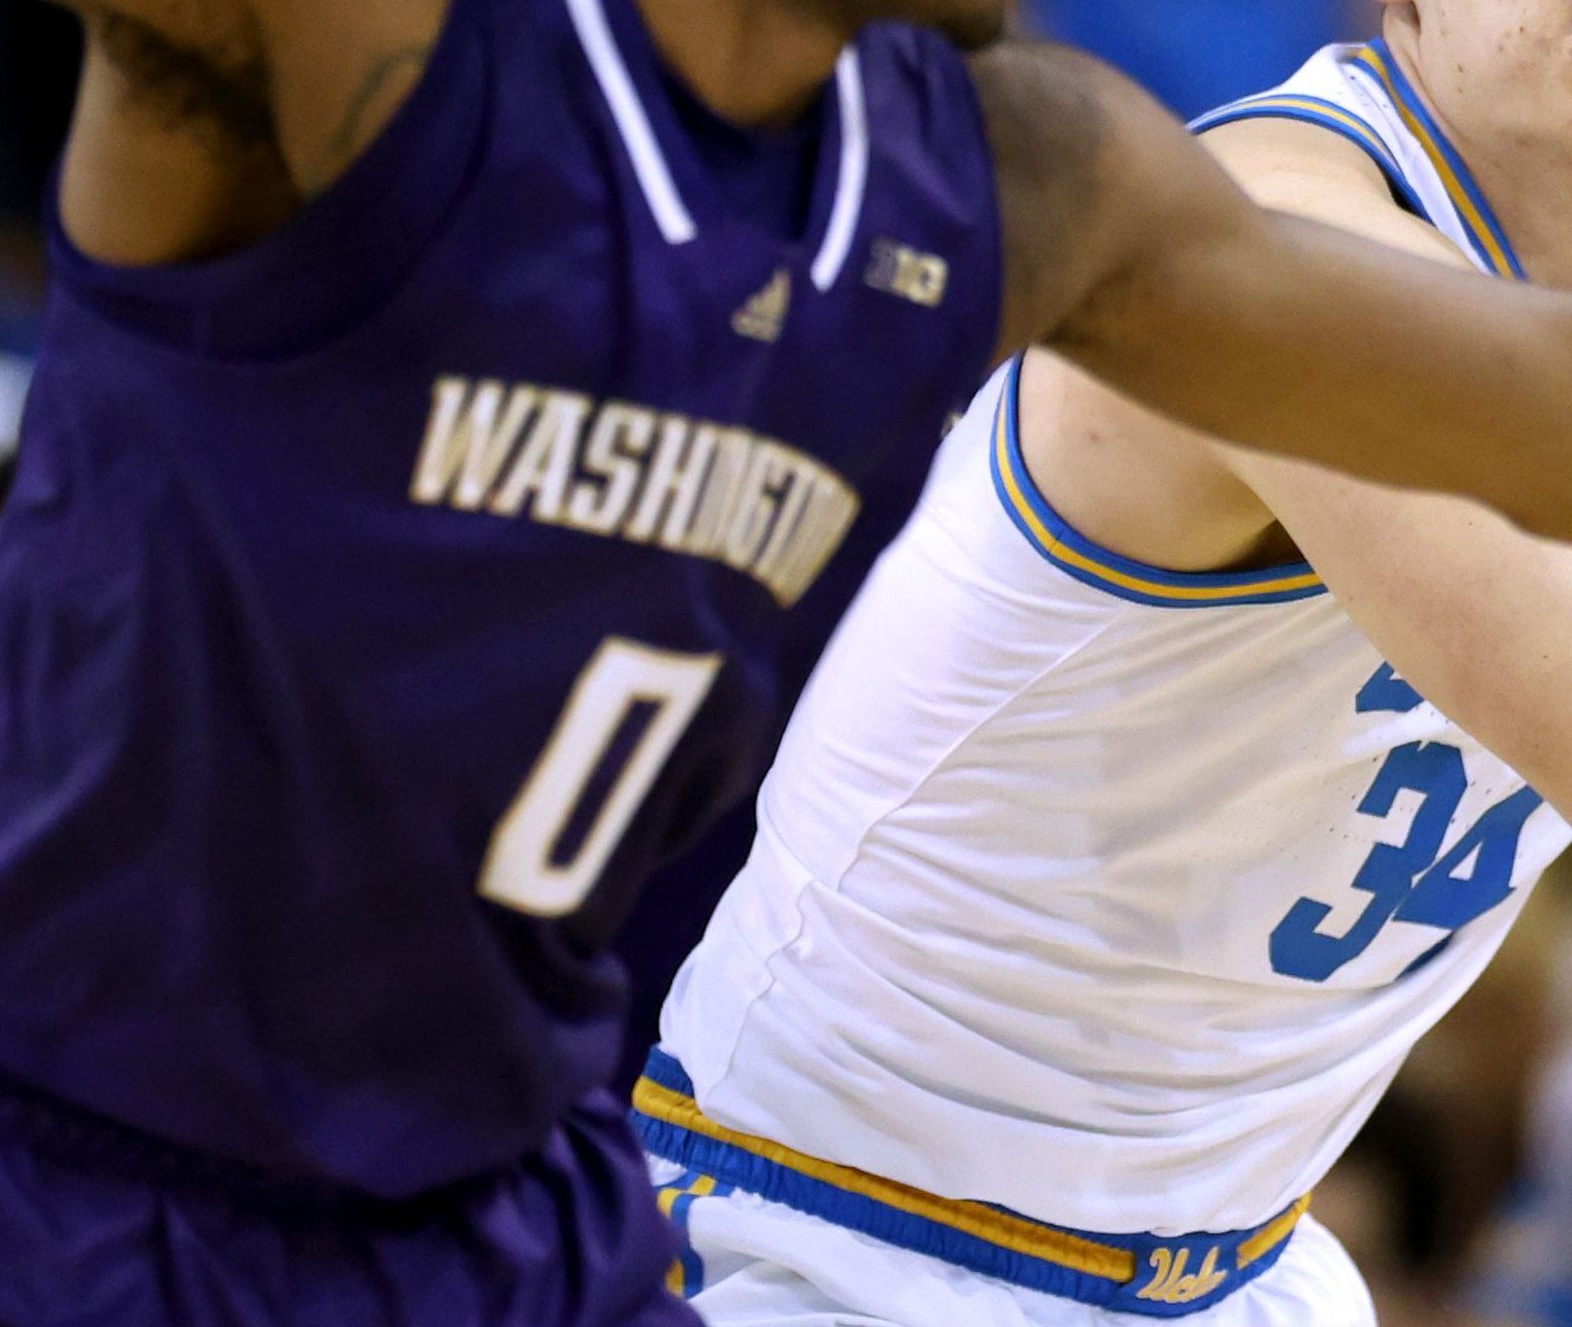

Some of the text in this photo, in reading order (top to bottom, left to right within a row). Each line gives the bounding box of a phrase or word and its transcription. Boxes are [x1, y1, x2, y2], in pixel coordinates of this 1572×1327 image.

[410, 376, 861, 609] WASHINGT
[478, 636, 722, 917] 0
[1269, 740, 1543, 982] 34
